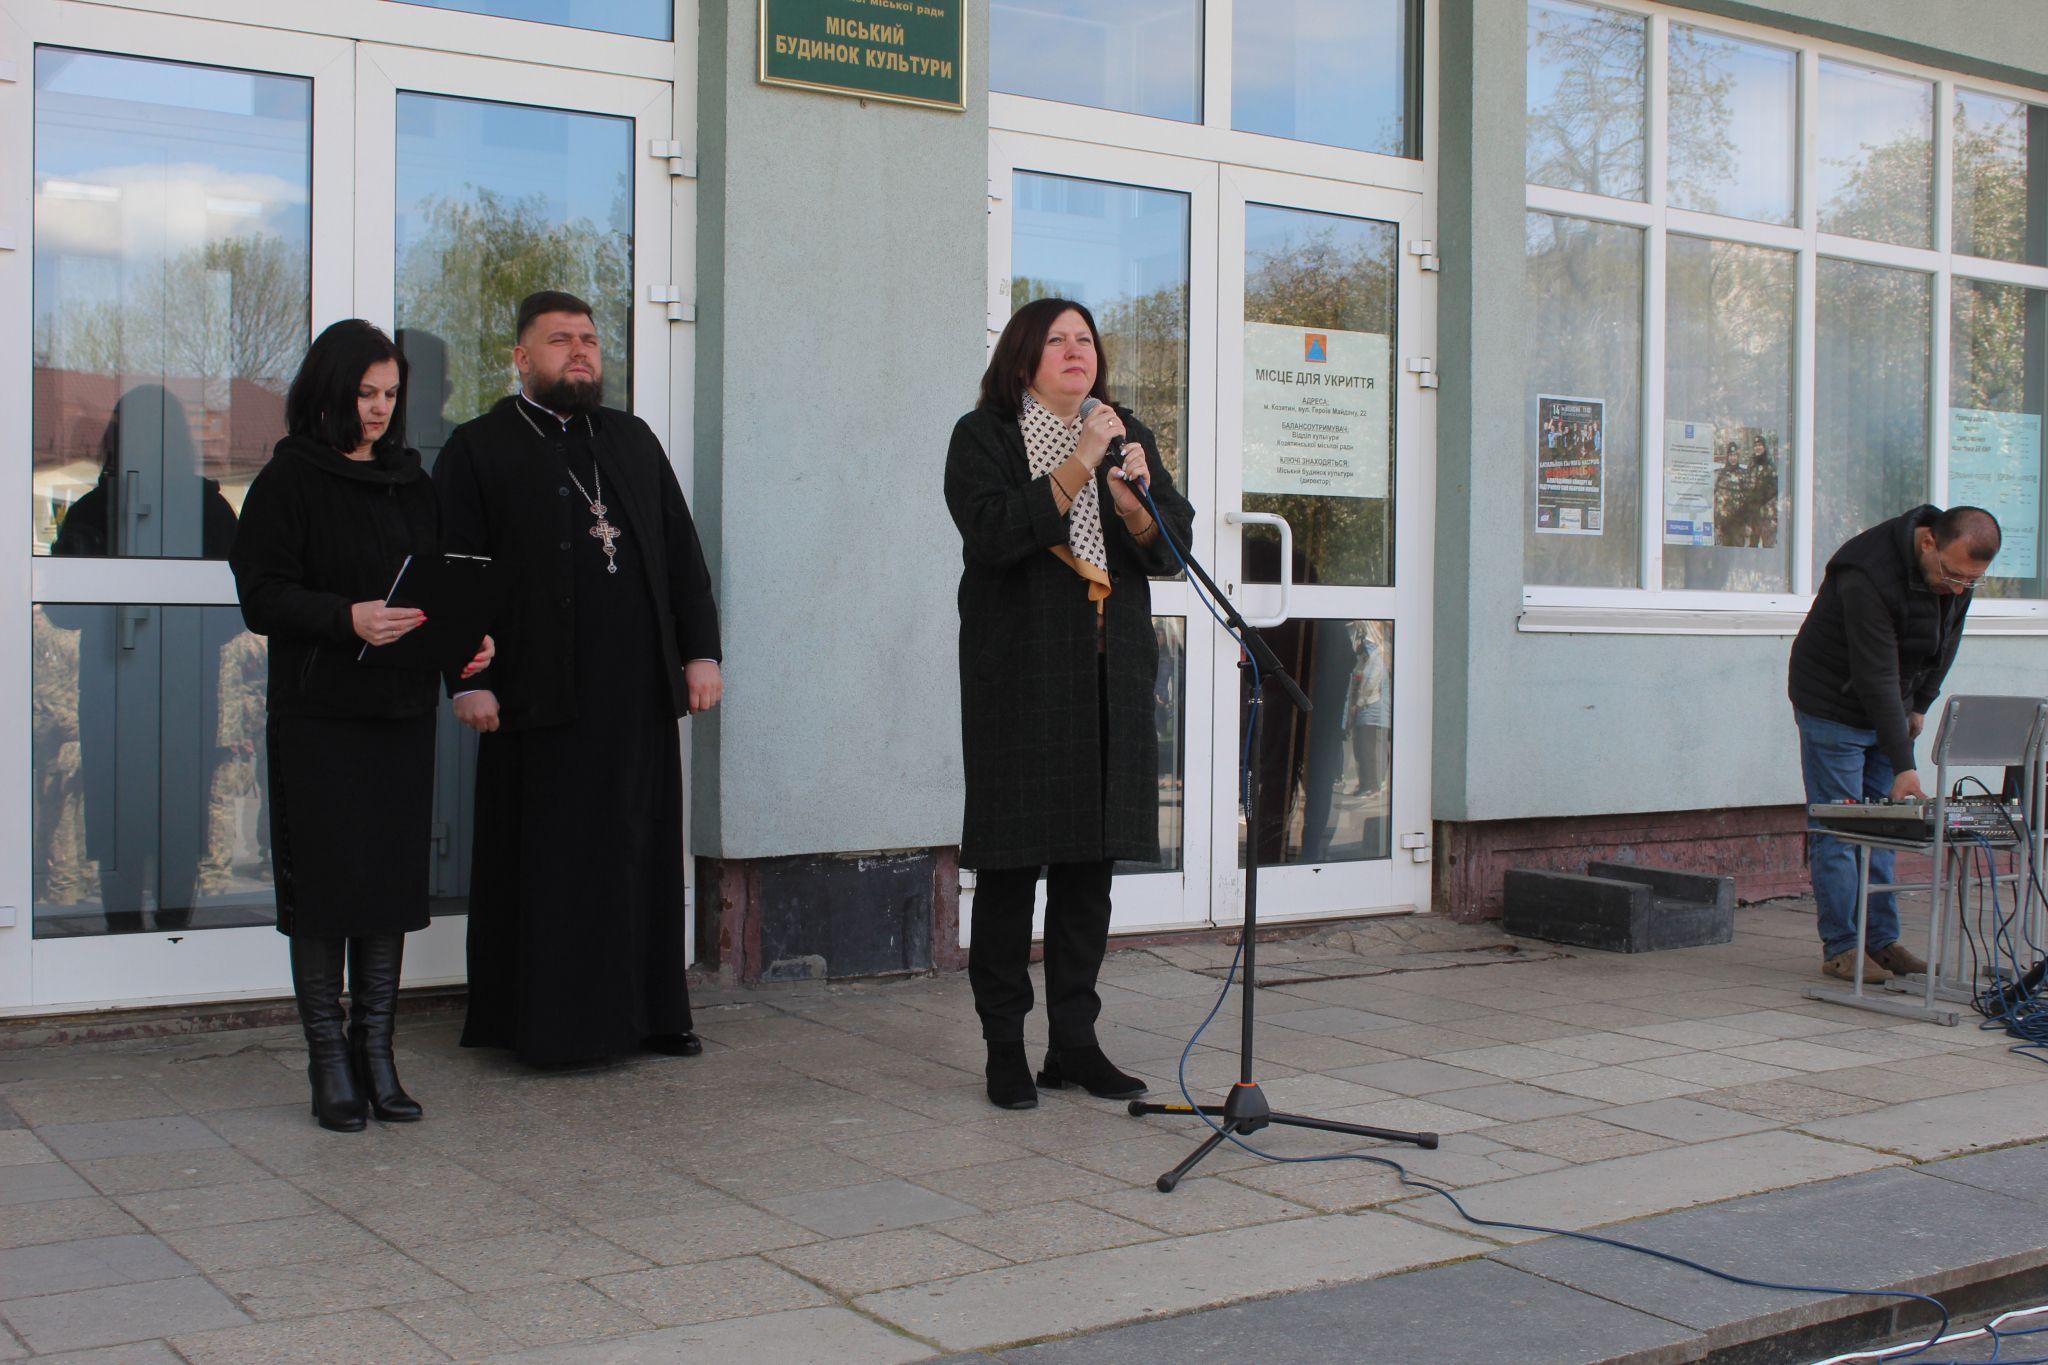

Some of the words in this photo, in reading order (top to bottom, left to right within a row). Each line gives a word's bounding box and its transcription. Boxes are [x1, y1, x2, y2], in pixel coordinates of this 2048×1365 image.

[917, 6, 945, 18] ради
[826, 16, 905, 46] МІСЬКИЙ
[775, 34, 860, 65] БУДИНОК
[865, 48, 952, 80] КУЛЬТУРИ
[1255, 368, 1293, 384] МІСЦЕ
[1296, 372, 1321, 385] ДЛЯ
[1324, 373, 1375, 389] УКРИТТЯ
